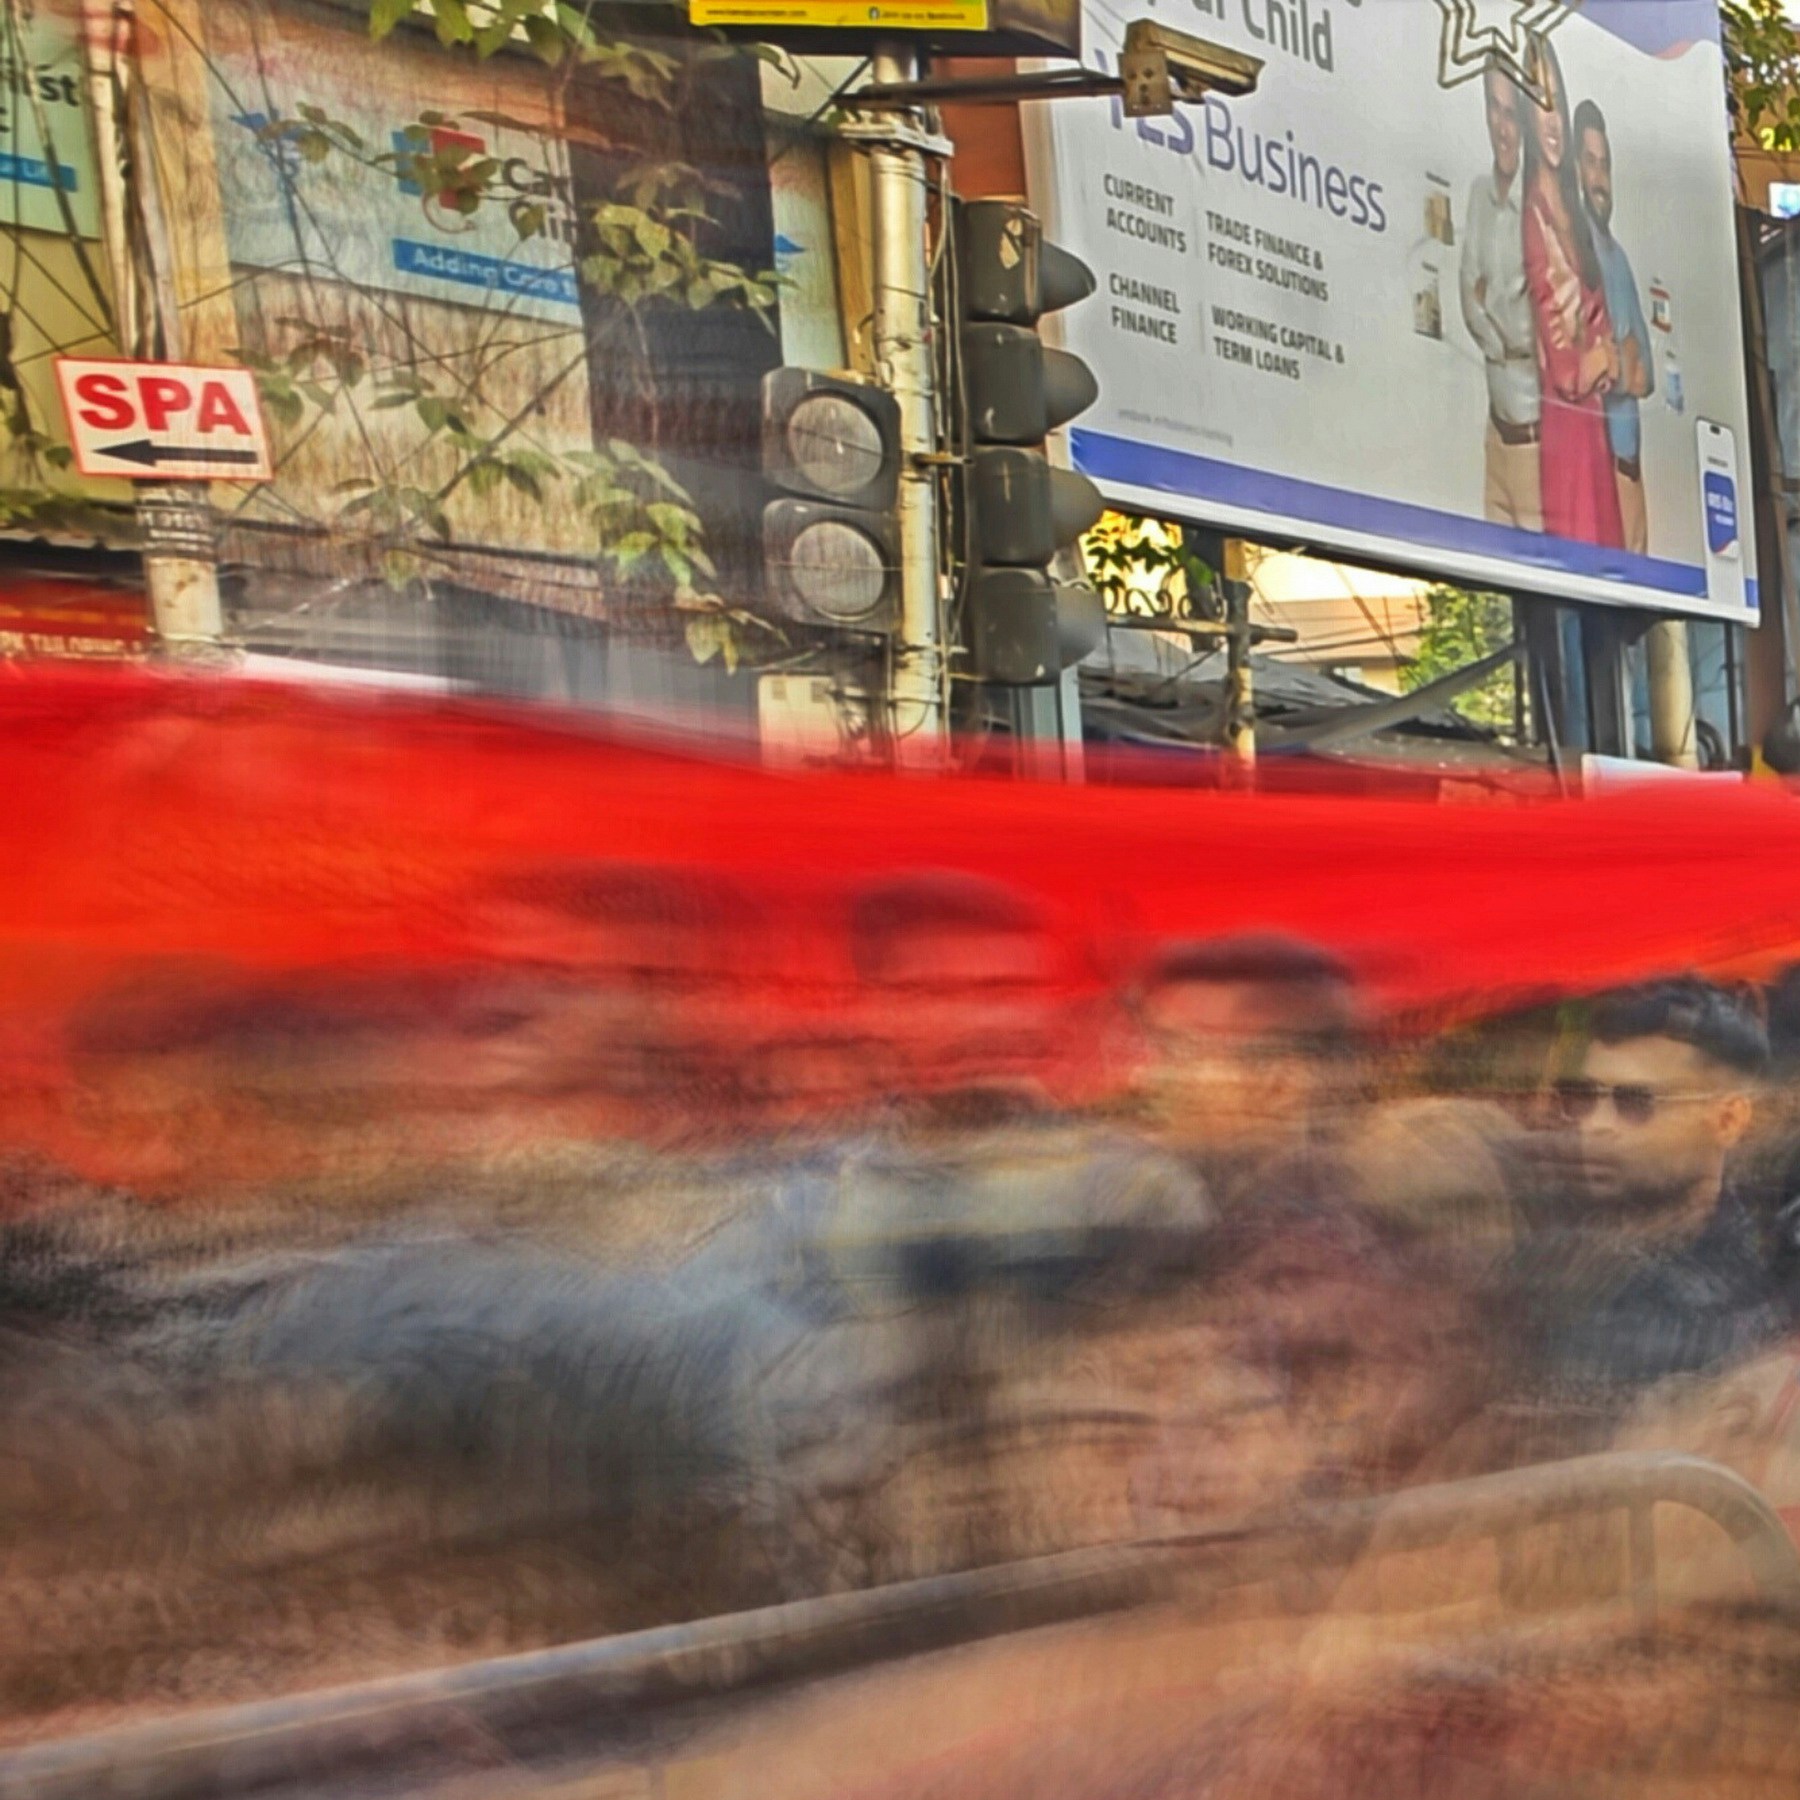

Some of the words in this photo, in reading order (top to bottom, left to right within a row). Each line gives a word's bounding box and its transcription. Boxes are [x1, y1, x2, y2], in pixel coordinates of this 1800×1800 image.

[1205, 96, 1386, 232] Business
[1104, 173, 1174, 217] CURRENT
[1106, 207, 1187, 253] ACCOUNTS
[1206, 210, 1251, 245] TRADE
[1255, 229, 1311, 267] FINANCE
[1313, 250, 1323, 270] &
[414, 248, 498, 290] Adding
[1208, 242, 1254, 275] FOREX
[1256, 259, 1329, 302] SOLUTIONS
[1109, 273, 1181, 314] CHANNEL
[1111, 305, 1178, 344] FINANCE
[1211, 304, 1278, 344] WORKING
[1280, 326, 1332, 361] CAPITAL
[1334, 344, 1345, 364] &
[1213, 337, 1253, 366] TERM
[1256, 350, 1300, 380] LOANS
[75, 374, 252, 435] SPA
